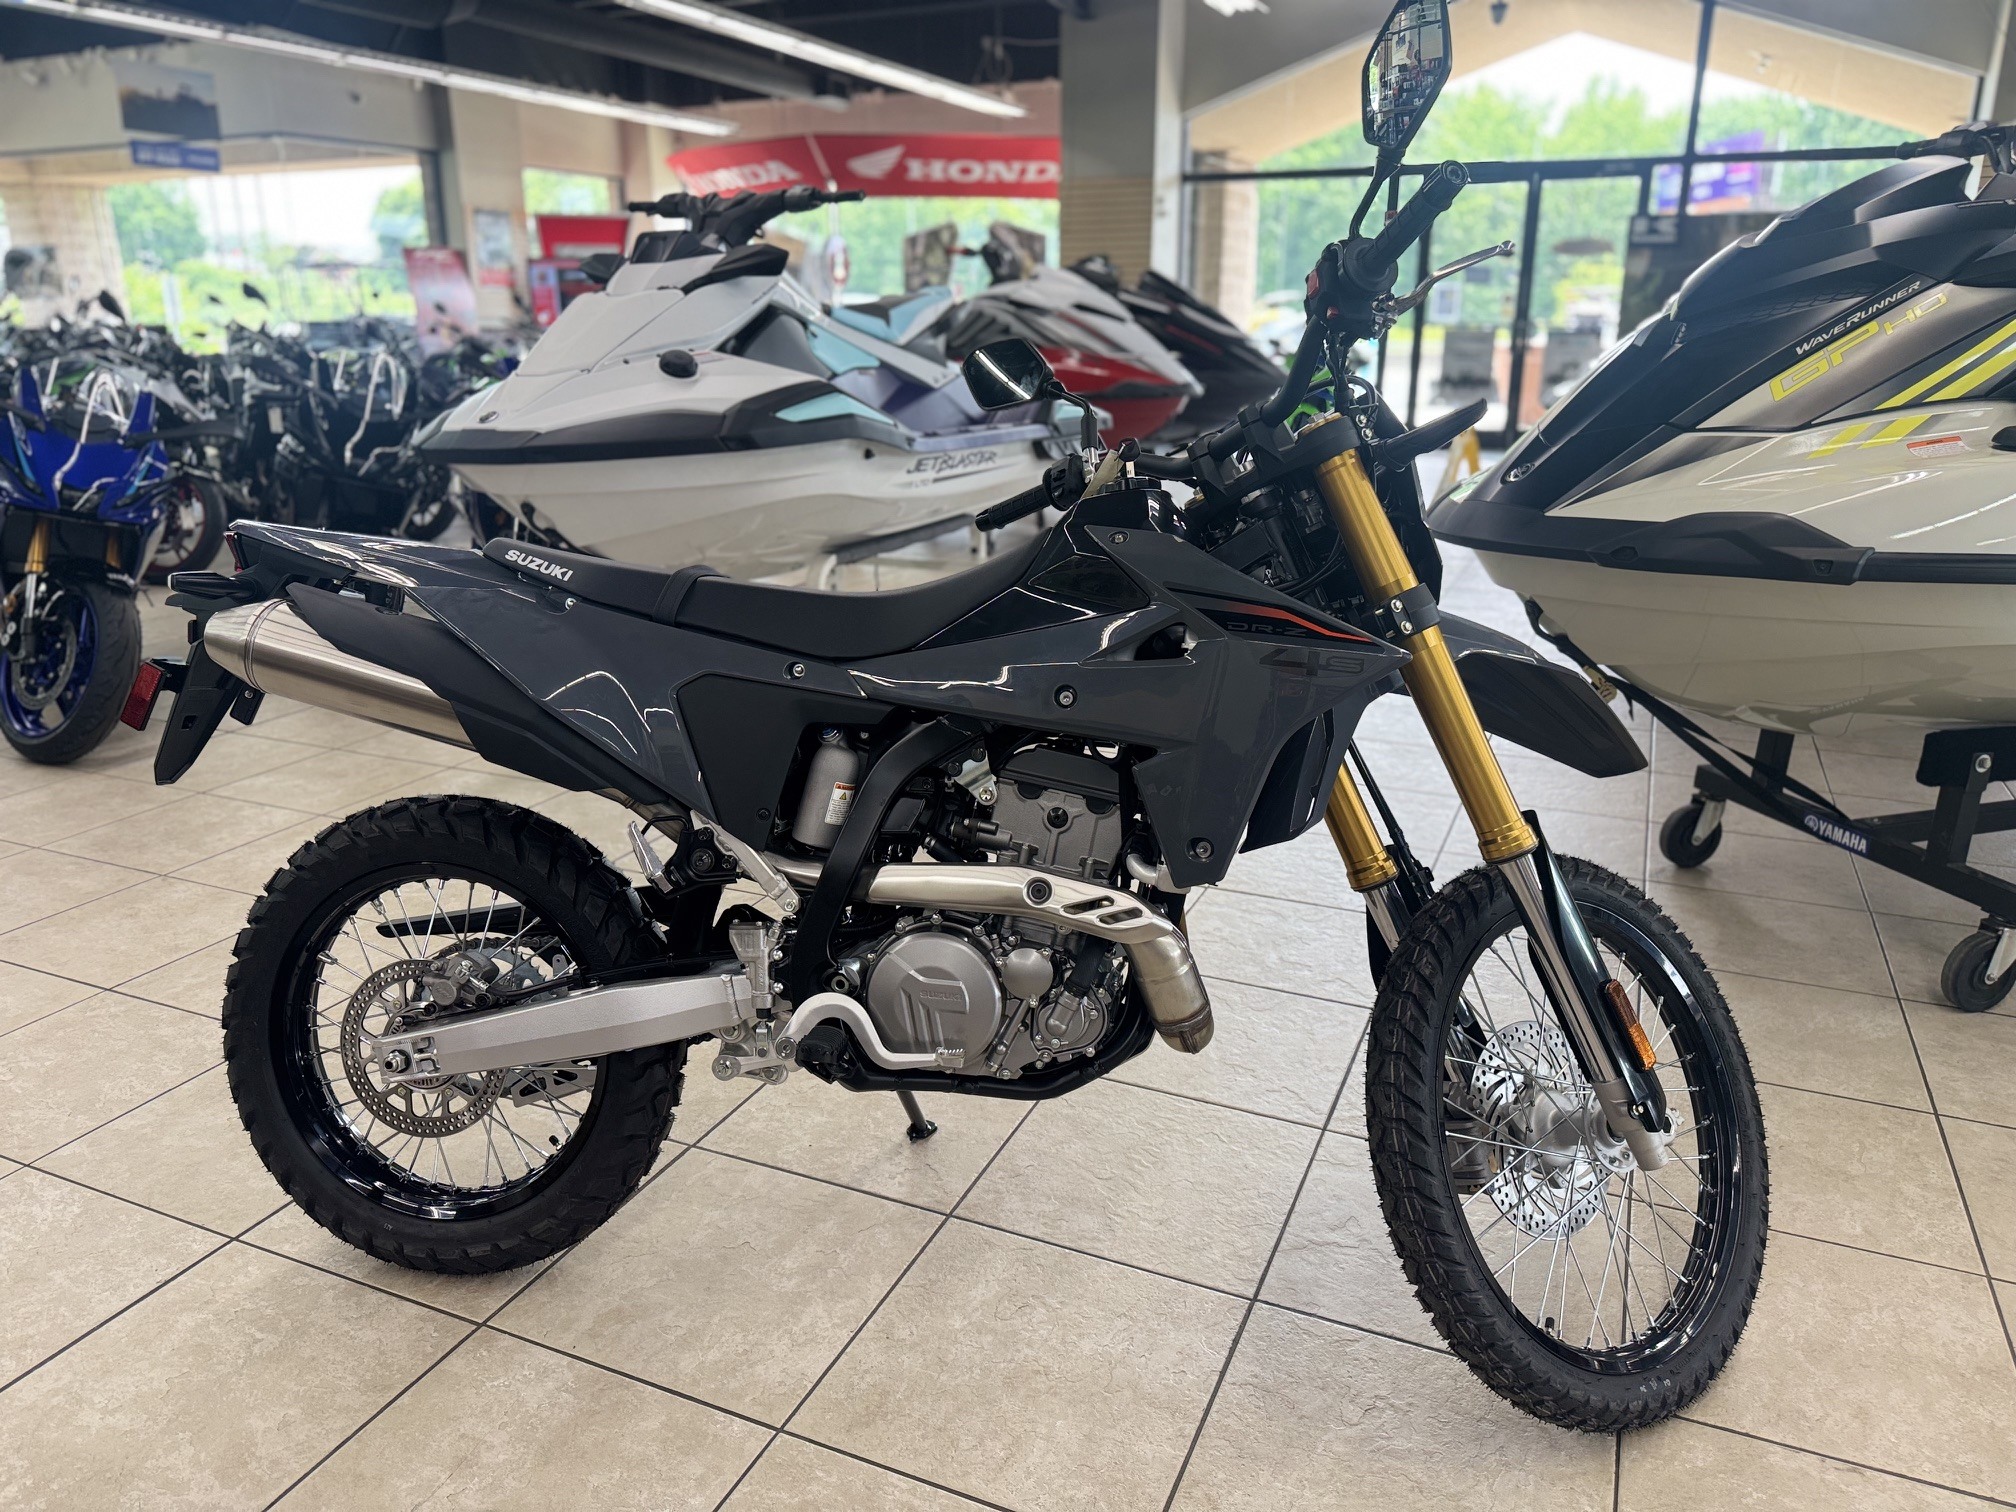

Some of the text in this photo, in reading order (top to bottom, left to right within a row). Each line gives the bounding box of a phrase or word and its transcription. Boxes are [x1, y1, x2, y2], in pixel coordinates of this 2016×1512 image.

[904, 157, 1062, 184] HOND
[1795, 280, 1921, 356] WAVERUNNER
[1769, 320, 1880, 402] GP
[504, 549, 574, 582] SUZUKI
[1226, 621, 1308, 637] DR-Z
[1259, 647, 1365, 677] 4S
[1819, 819, 1867, 854] YAMAHA
[919, 989, 963, 1002] SUZUKI
